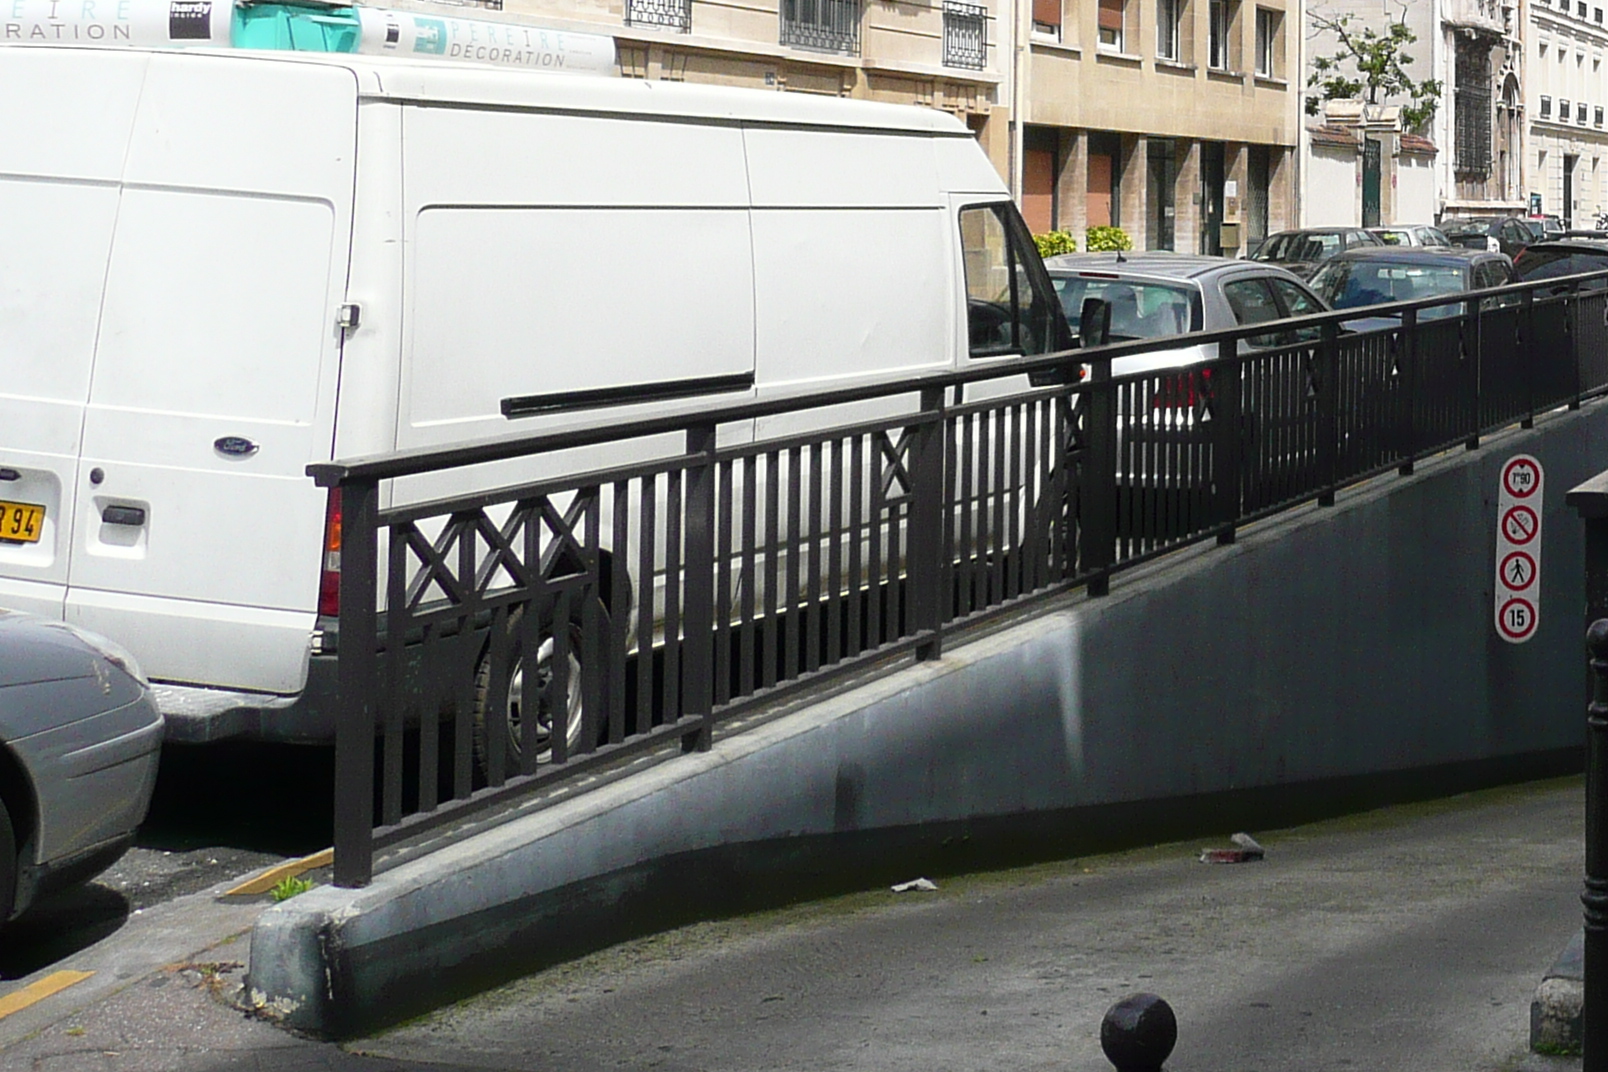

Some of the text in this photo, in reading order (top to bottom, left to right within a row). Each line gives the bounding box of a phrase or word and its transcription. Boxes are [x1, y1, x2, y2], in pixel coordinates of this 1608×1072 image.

[171, 2, 212, 14] hardy
[450, 21, 565, 51] PEREIRE
[450, 41, 566, 68] DÉCORATION
[11, 508, 35, 537] 94
[1509, 609, 1525, 627] 15
